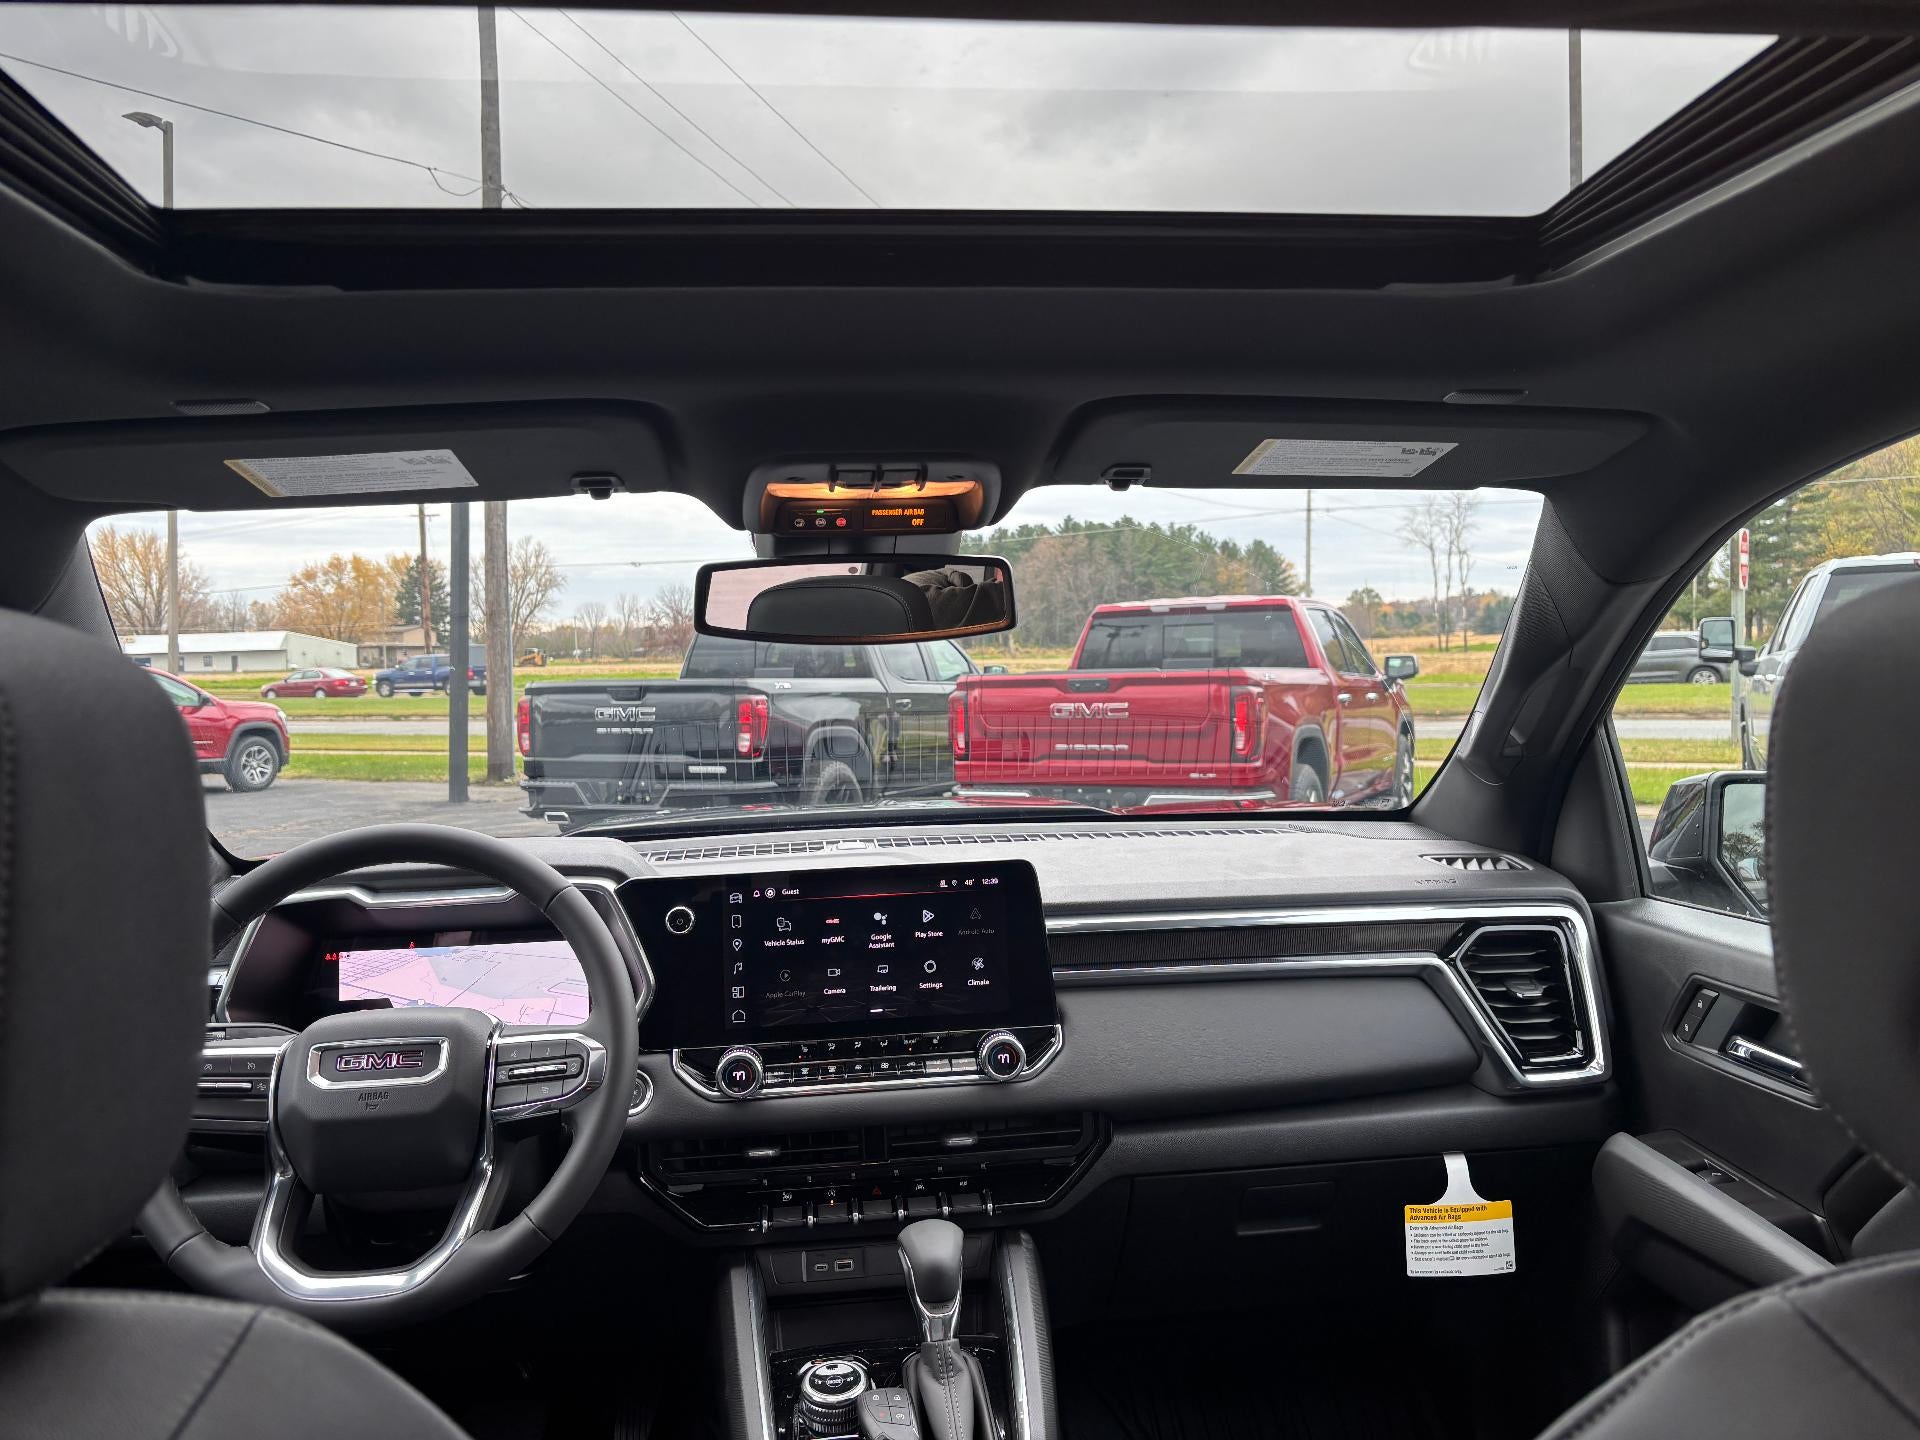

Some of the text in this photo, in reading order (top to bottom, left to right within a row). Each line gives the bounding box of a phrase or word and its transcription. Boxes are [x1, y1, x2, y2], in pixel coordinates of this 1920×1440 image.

[871, 508, 903, 516] PASSENGER
[911, 518, 925, 526] OFF
[594, 706, 656, 721] GMC
[1050, 701, 1129, 719] GMC
[596, 727, 653, 735] SIERRA
[781, 888, 800, 896] Guest
[870, 933, 892, 942] Google
[915, 930, 944, 939] Play Store
[764, 938, 805, 947] Vehicle Status
[821, 936, 845, 945] myGMC
[868, 941, 895, 949] Assistant
[919, 981, 943, 990] Settings
[967, 978, 990, 986] Climate
[823, 987, 846, 995] Camera
[869, 984, 897, 993] Trailering
[336, 1050, 424, 1072] GMC
[358, 1091, 390, 1102] AIRBAG
[1450, 1206, 1475, 1214] Equipped
[1447, 1213, 1462, 1222] Bags
